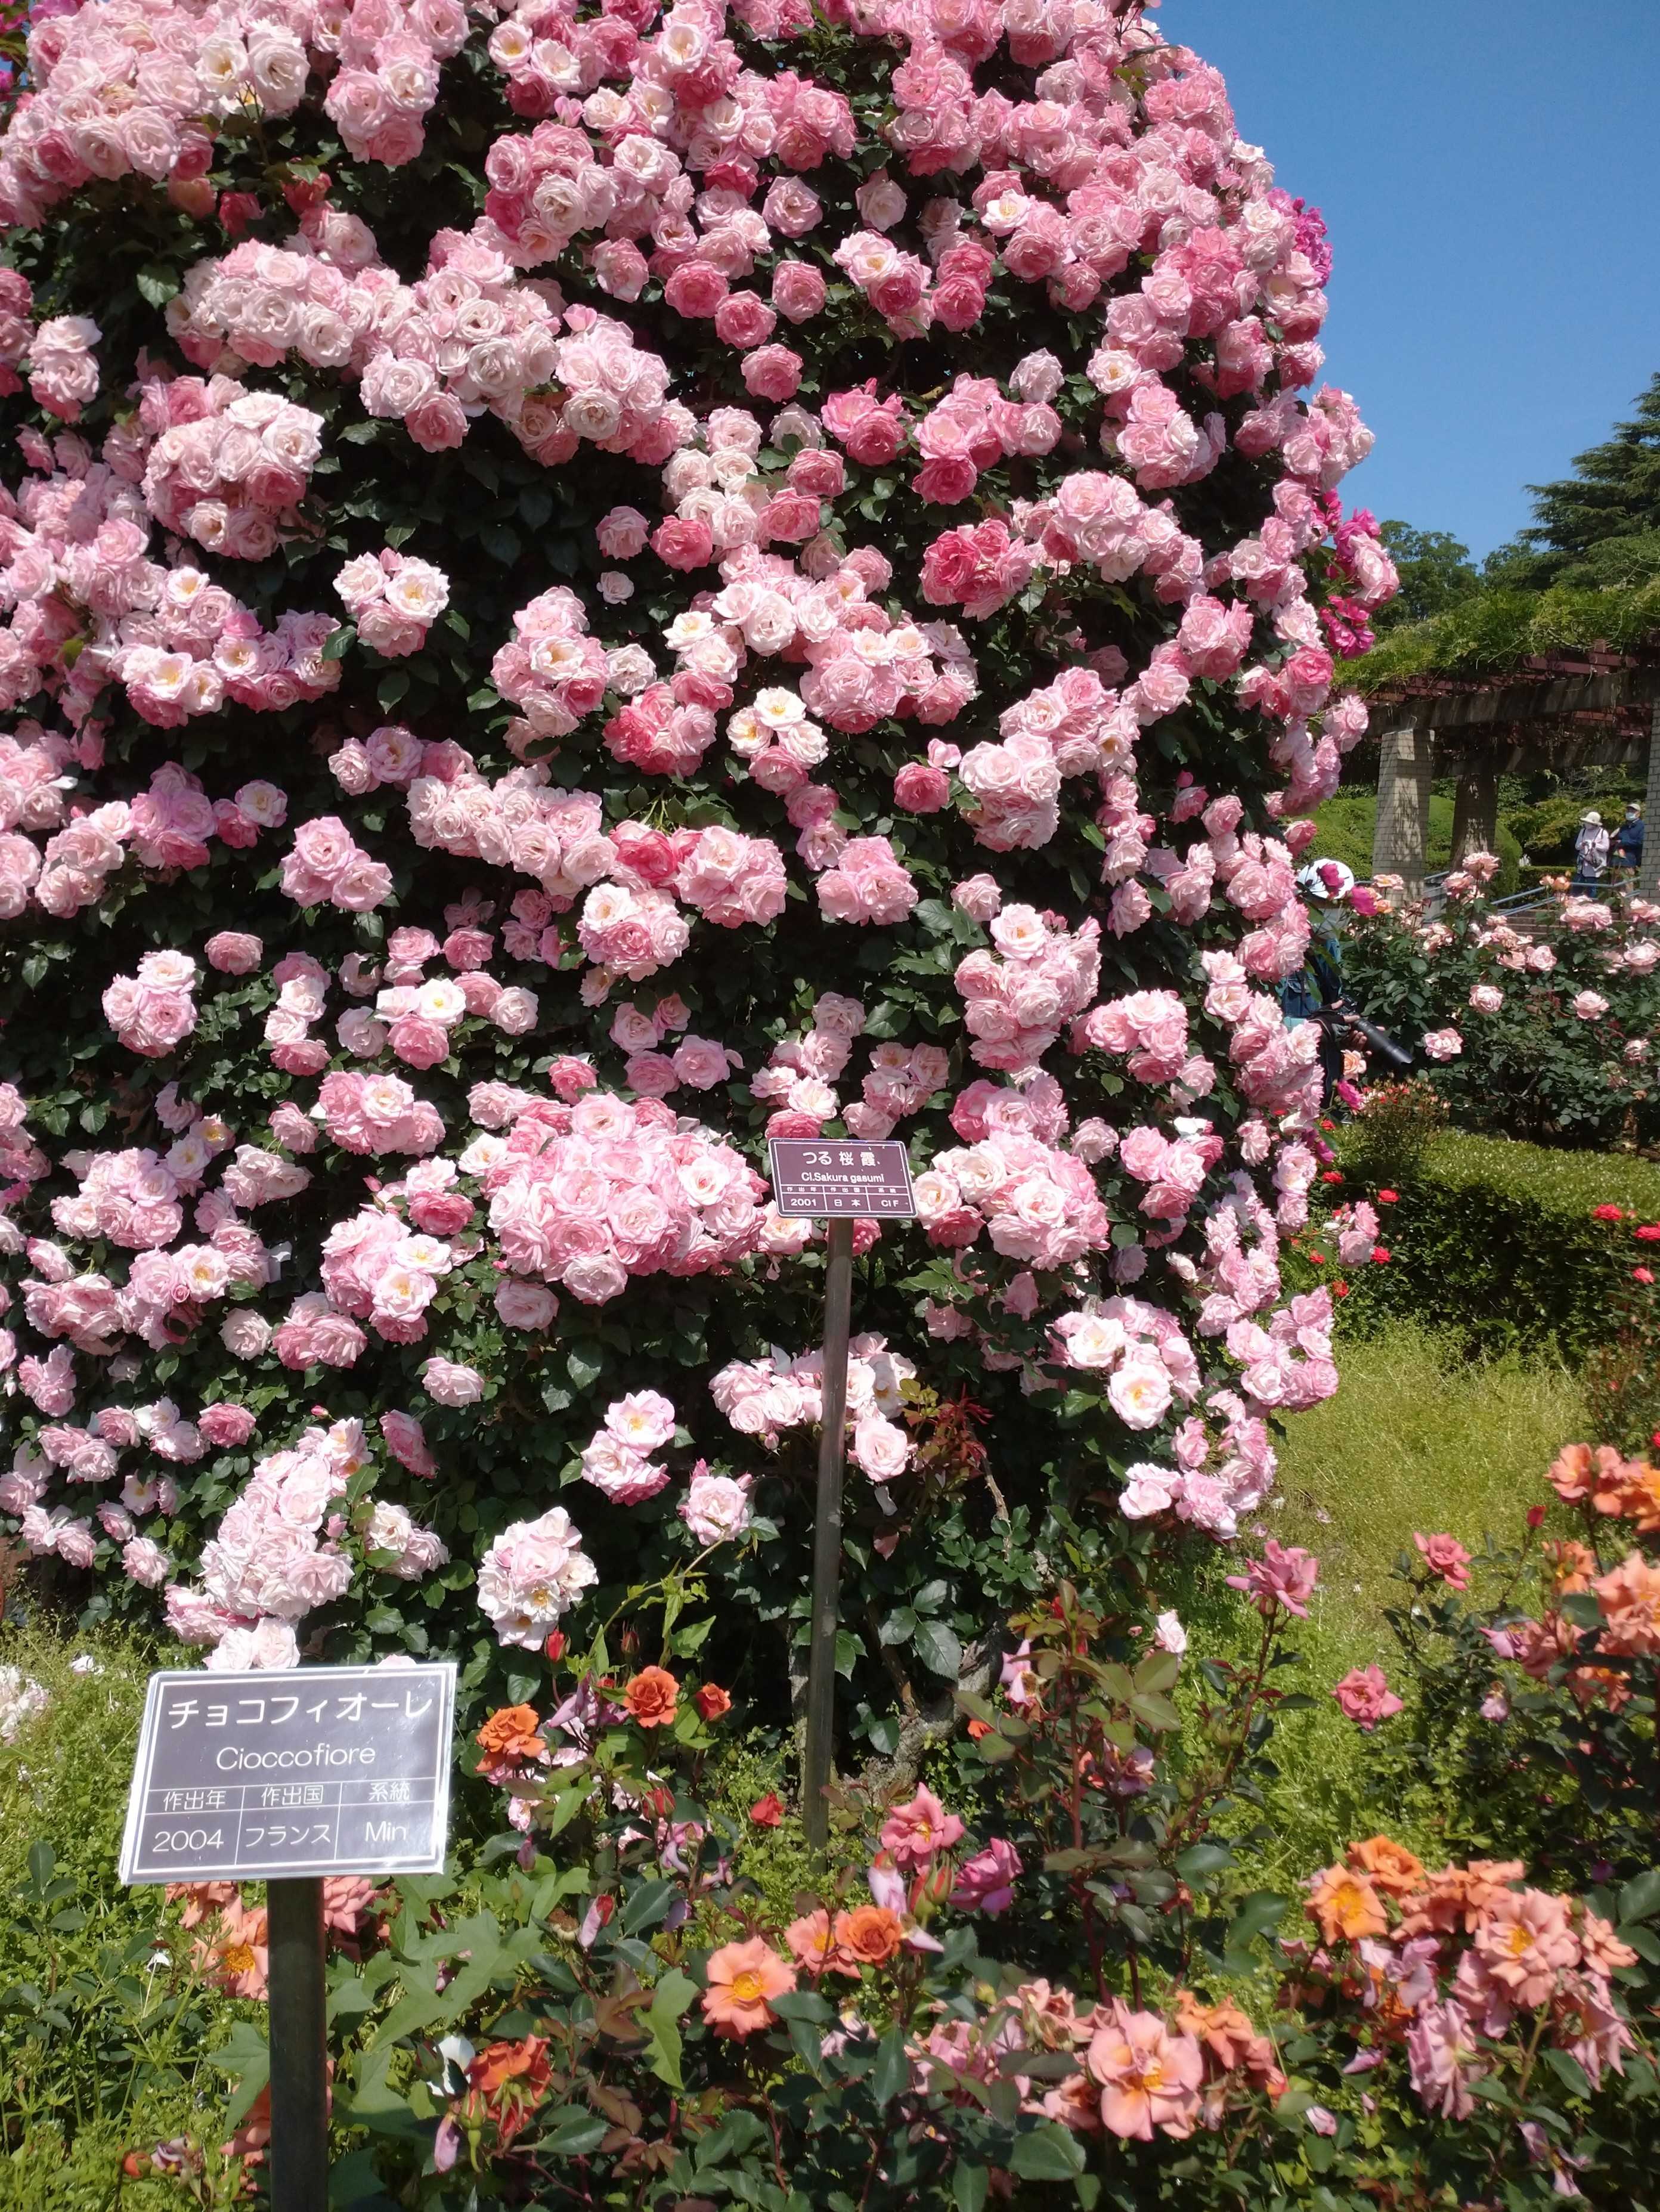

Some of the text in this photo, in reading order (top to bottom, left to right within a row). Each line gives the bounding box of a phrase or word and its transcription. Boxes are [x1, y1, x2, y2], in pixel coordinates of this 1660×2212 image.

[801, 1172, 885, 1184] Cl.Sakura gasumi
[834, 1199, 861, 1207] 日本
[168, 1690, 433, 1730] チョコフィオーレ
[216, 1742, 376, 1770] Cioccofiore
[162, 1790, 227, 1811] 作出年
[261, 1785, 324, 1807] 作出国
[368, 1782, 411, 1802] 系統
[152, 1829, 224, 1852] 2004
[245, 1823, 332, 1848] フランス
[365, 1820, 408, 1842] Min
